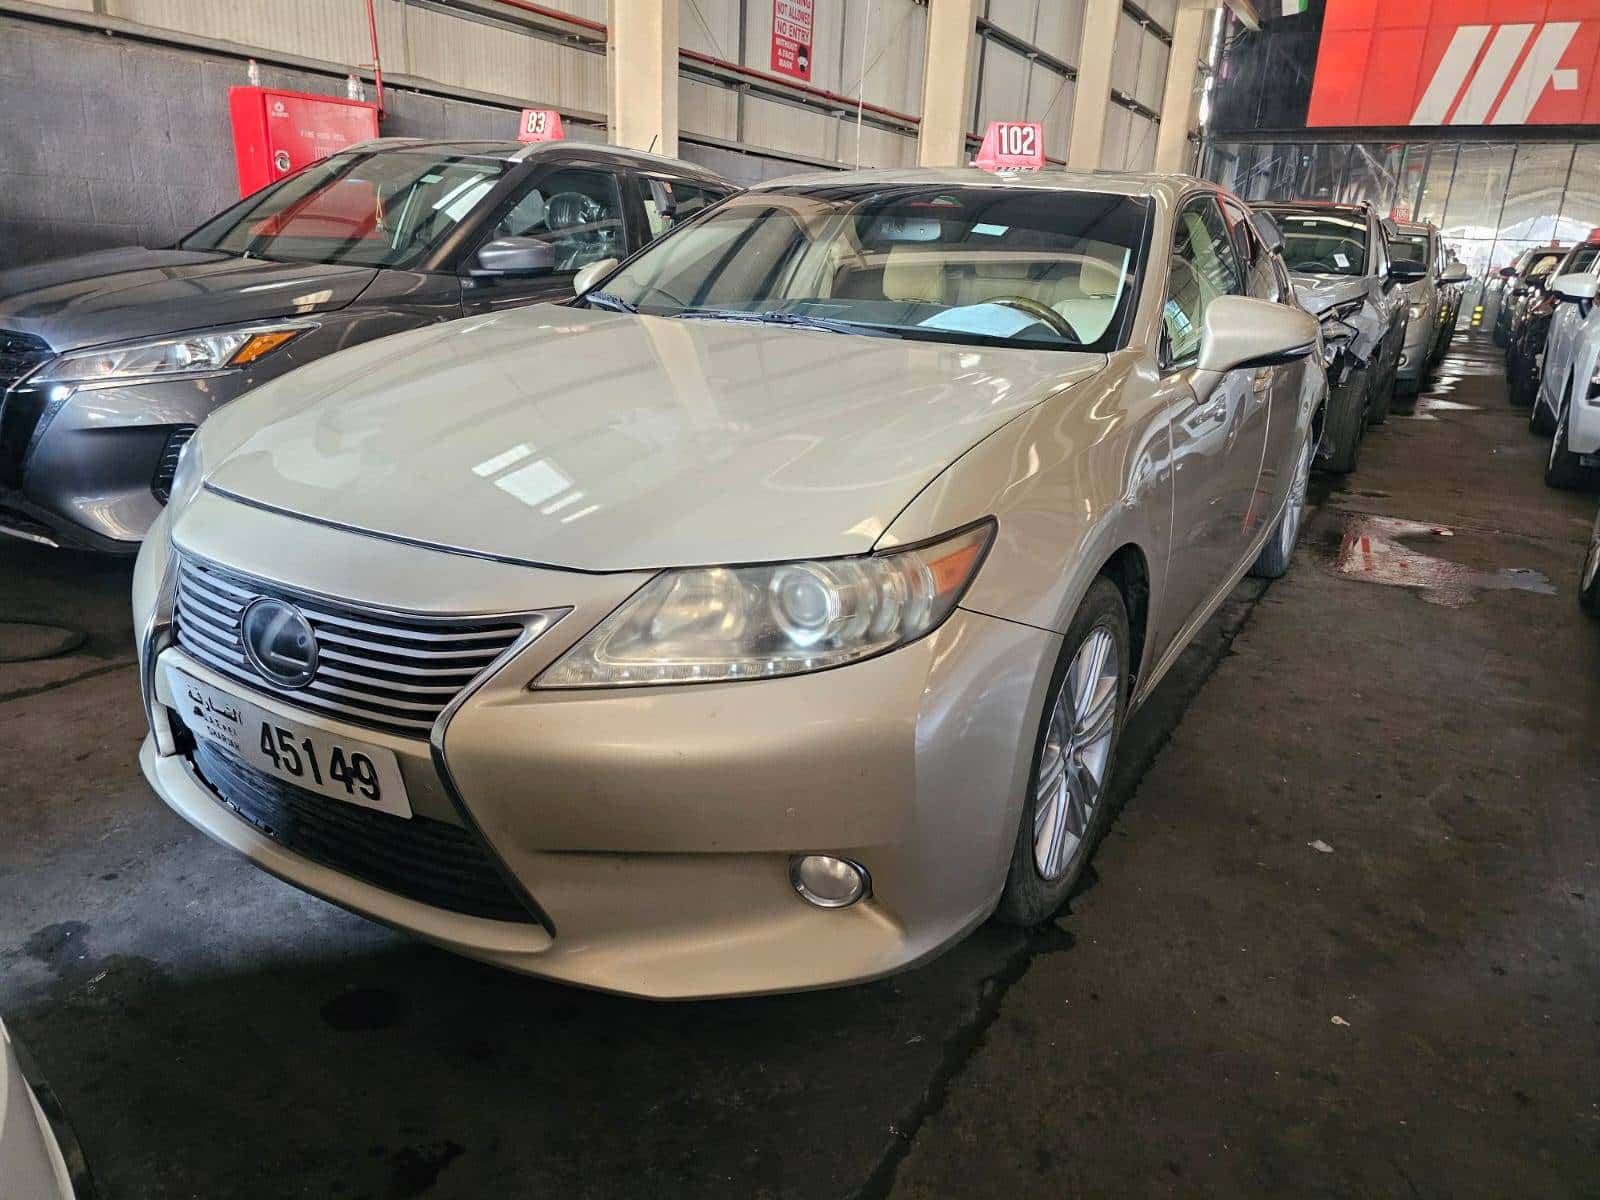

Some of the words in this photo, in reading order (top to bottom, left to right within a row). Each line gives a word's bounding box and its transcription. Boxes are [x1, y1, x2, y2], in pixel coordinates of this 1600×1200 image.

[777, 2, 789, 16] NOT
[789, 5, 810, 25] ALLOWED
[777, 20, 787, 35] NO
[789, 25, 810, 43] ENTRY
[527, 111, 546, 133] 83
[999, 125, 1035, 155] 102
[260, 721, 382, 802] 45149
